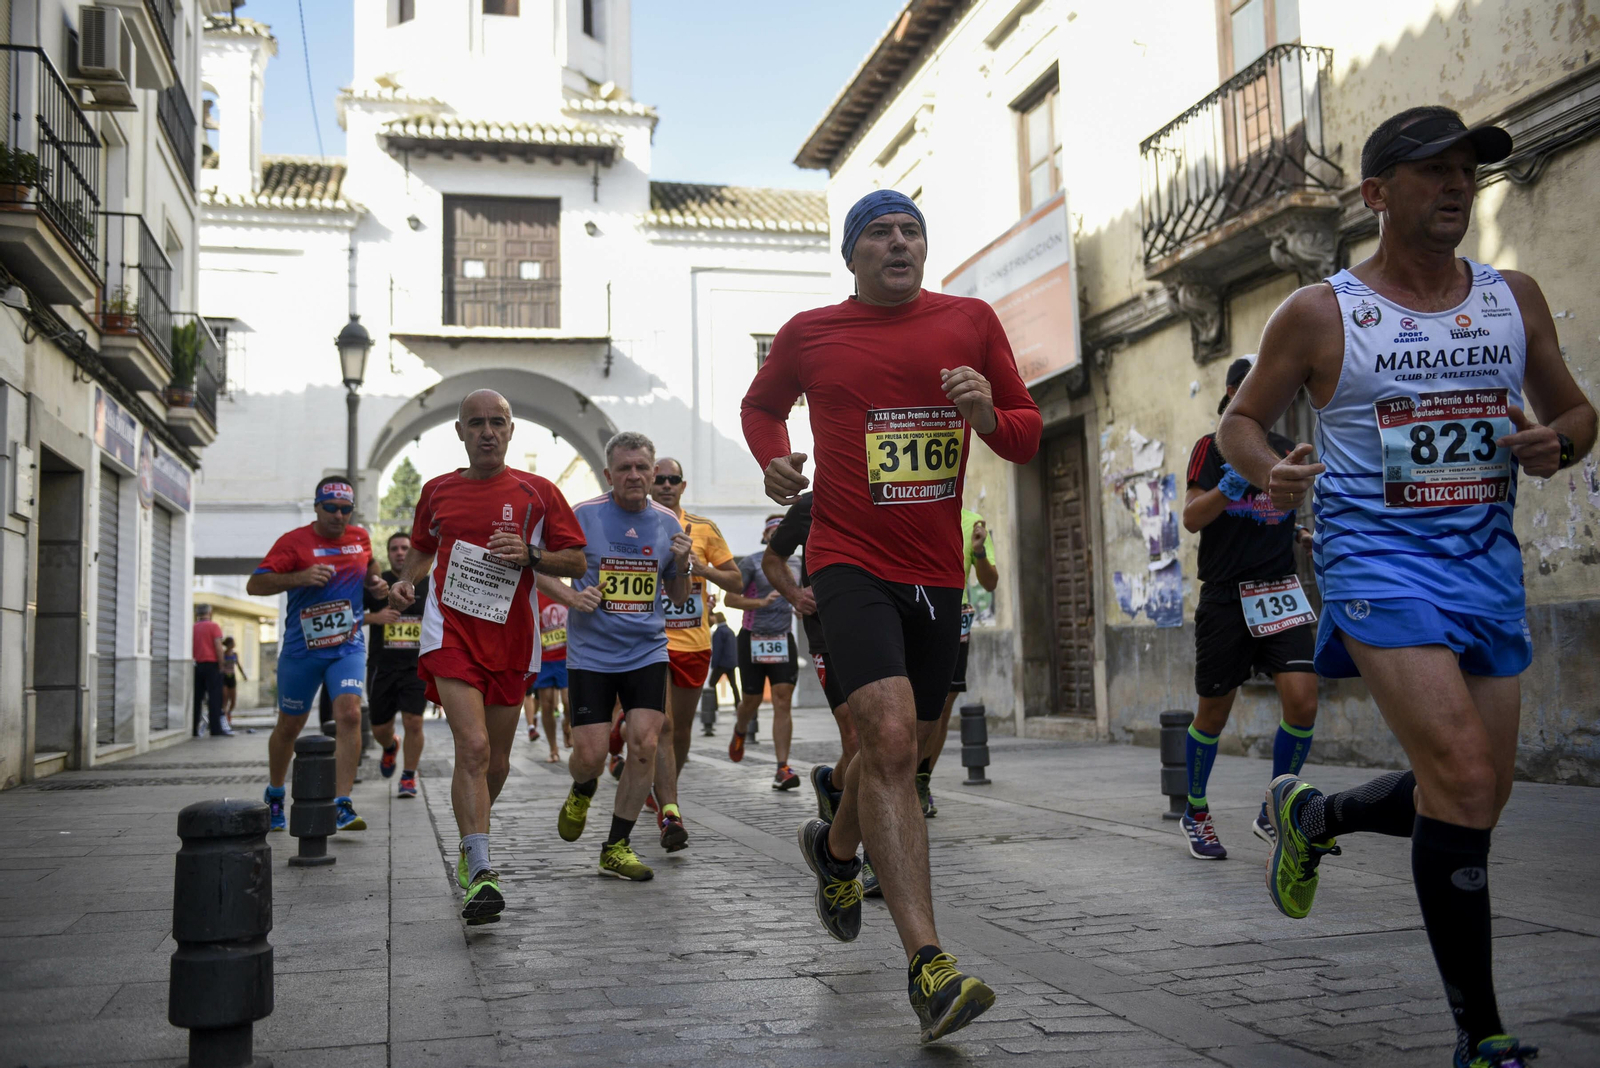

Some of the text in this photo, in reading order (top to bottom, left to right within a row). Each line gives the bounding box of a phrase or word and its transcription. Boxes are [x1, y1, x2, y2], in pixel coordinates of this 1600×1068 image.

[983, 232, 1063, 287] CONSTRUCCIÓN
[1394, 336, 1430, 344] GARRIDO
[1451, 328, 1490, 340] mayfo
[1375, 345, 1512, 373] MARACENA
[1395, 374, 1423, 382] CLUB
[1441, 369, 1500, 380] ATLETISMO
[1434, 395, 1462, 407] Premio
[1465, 394, 1474, 404] de
[1476, 393, 1498, 404] Fondo
[874, 410, 957, 421] XXXI Gran Premio de Fondo
[1452, 406, 1484, 416] Cruzcampo
[1486, 405, 1507, 415] 2018
[890, 421, 916, 429] Diputación
[948, 420, 962, 429] 2018
[1410, 420, 1497, 465] 823
[878, 438, 960, 473] 3166
[882, 483, 947, 499] Cruzcampo
[1403, 483, 1497, 503] Cruzcampo
[609, 545, 639, 555] LISBOA
[460, 564, 485, 577] CORRO
[486, 571, 516, 587] CONTRA
[470, 575, 500, 590] CANCER
[457, 580, 481, 595] aecc
[605, 576, 655, 596] 3106
[606, 601, 648, 612] Cruzcampo
[1255, 594, 1298, 619] 139
[312, 612, 348, 633] 542
[666, 620, 695, 628] uzcampo
[1258, 616, 1306, 634] Cruzcampo
[389, 625, 420, 638] 3146
[759, 642, 783, 654] 136
